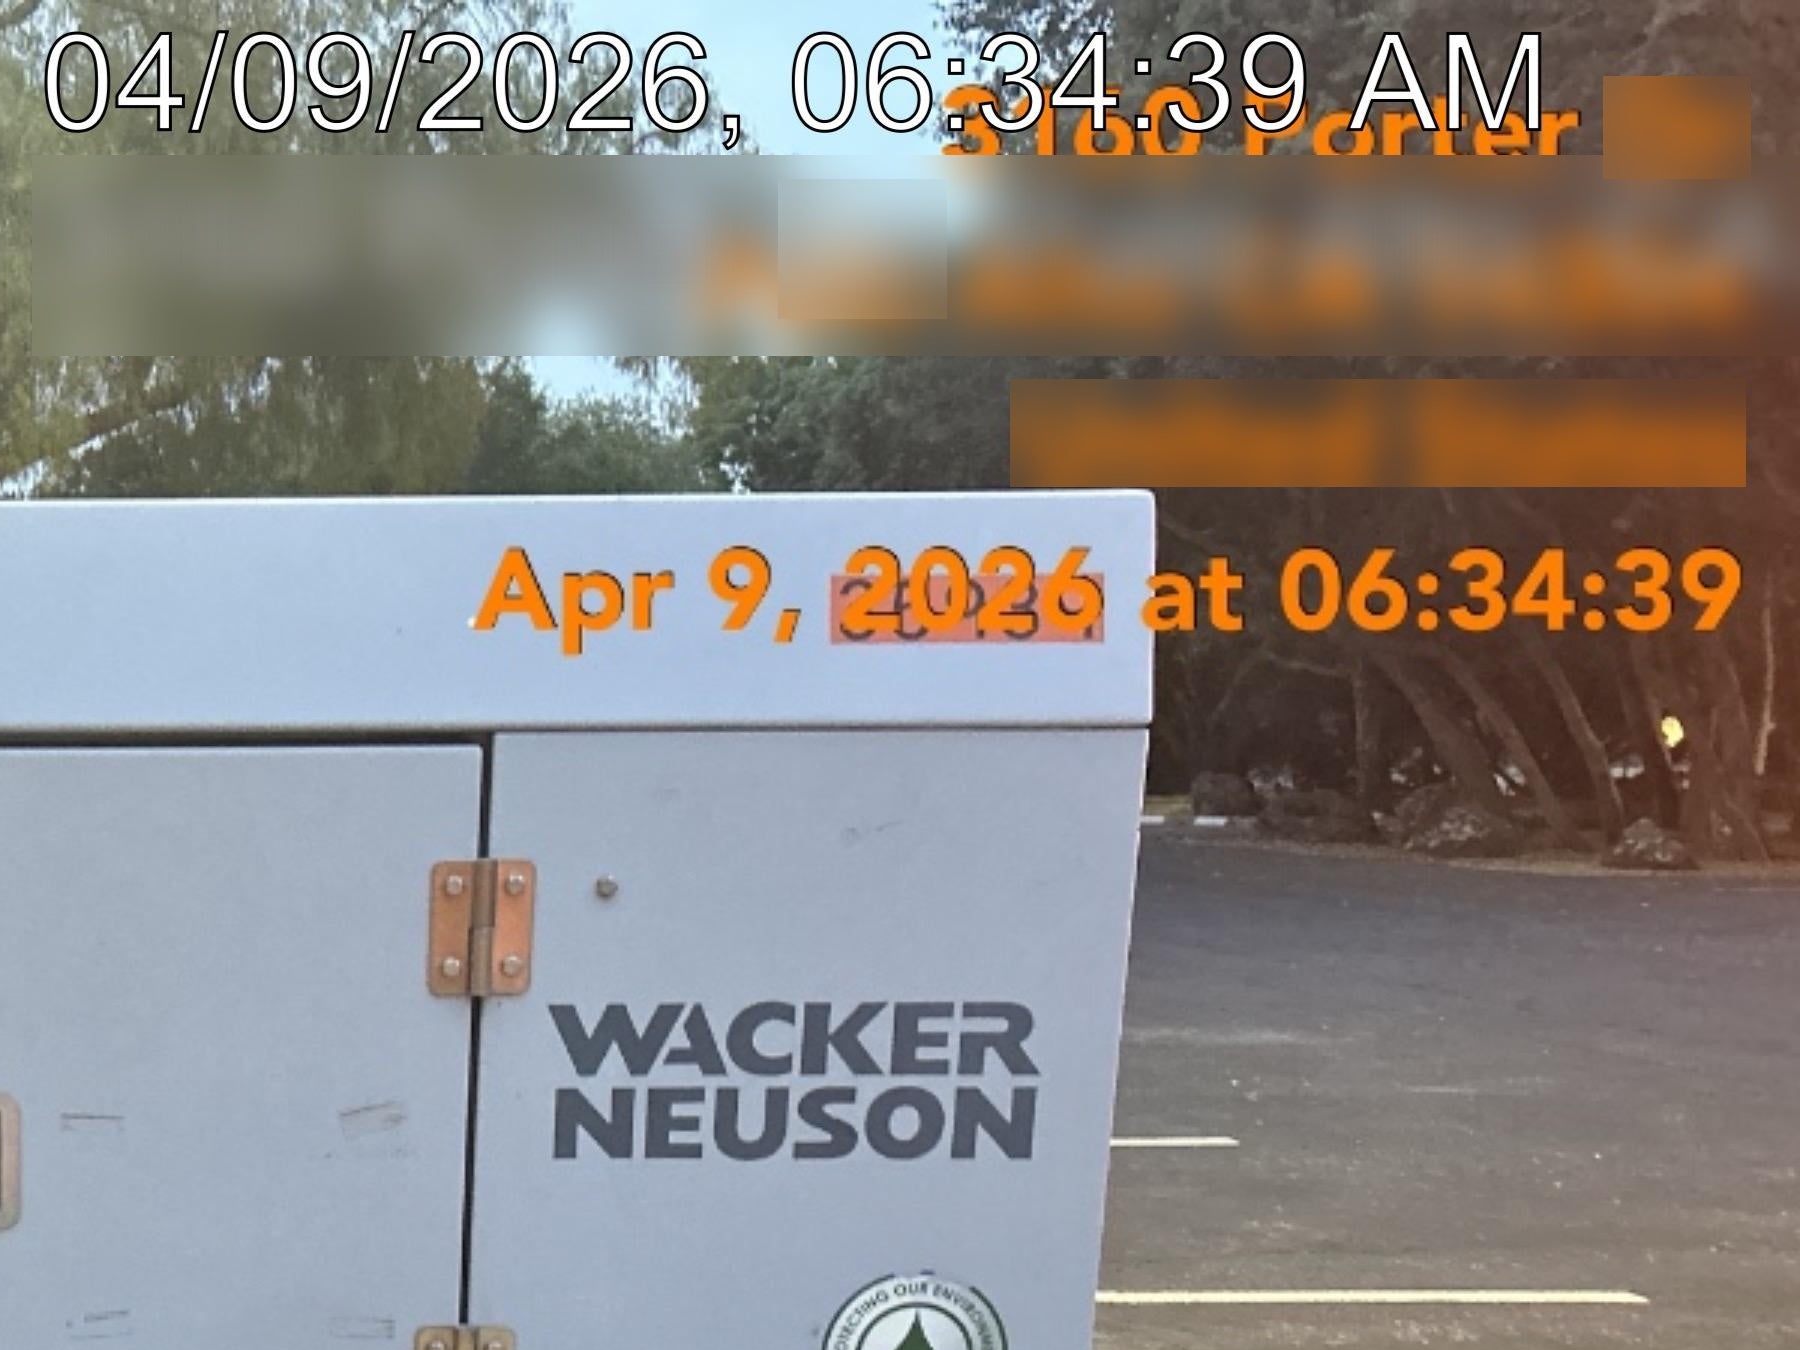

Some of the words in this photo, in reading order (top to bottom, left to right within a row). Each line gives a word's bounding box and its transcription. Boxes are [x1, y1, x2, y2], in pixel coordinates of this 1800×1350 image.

[547, 1000, 1041, 1077] WACKER
[552, 1085, 1038, 1161] NEUSON
[893, 1281, 928, 1298] OUR
